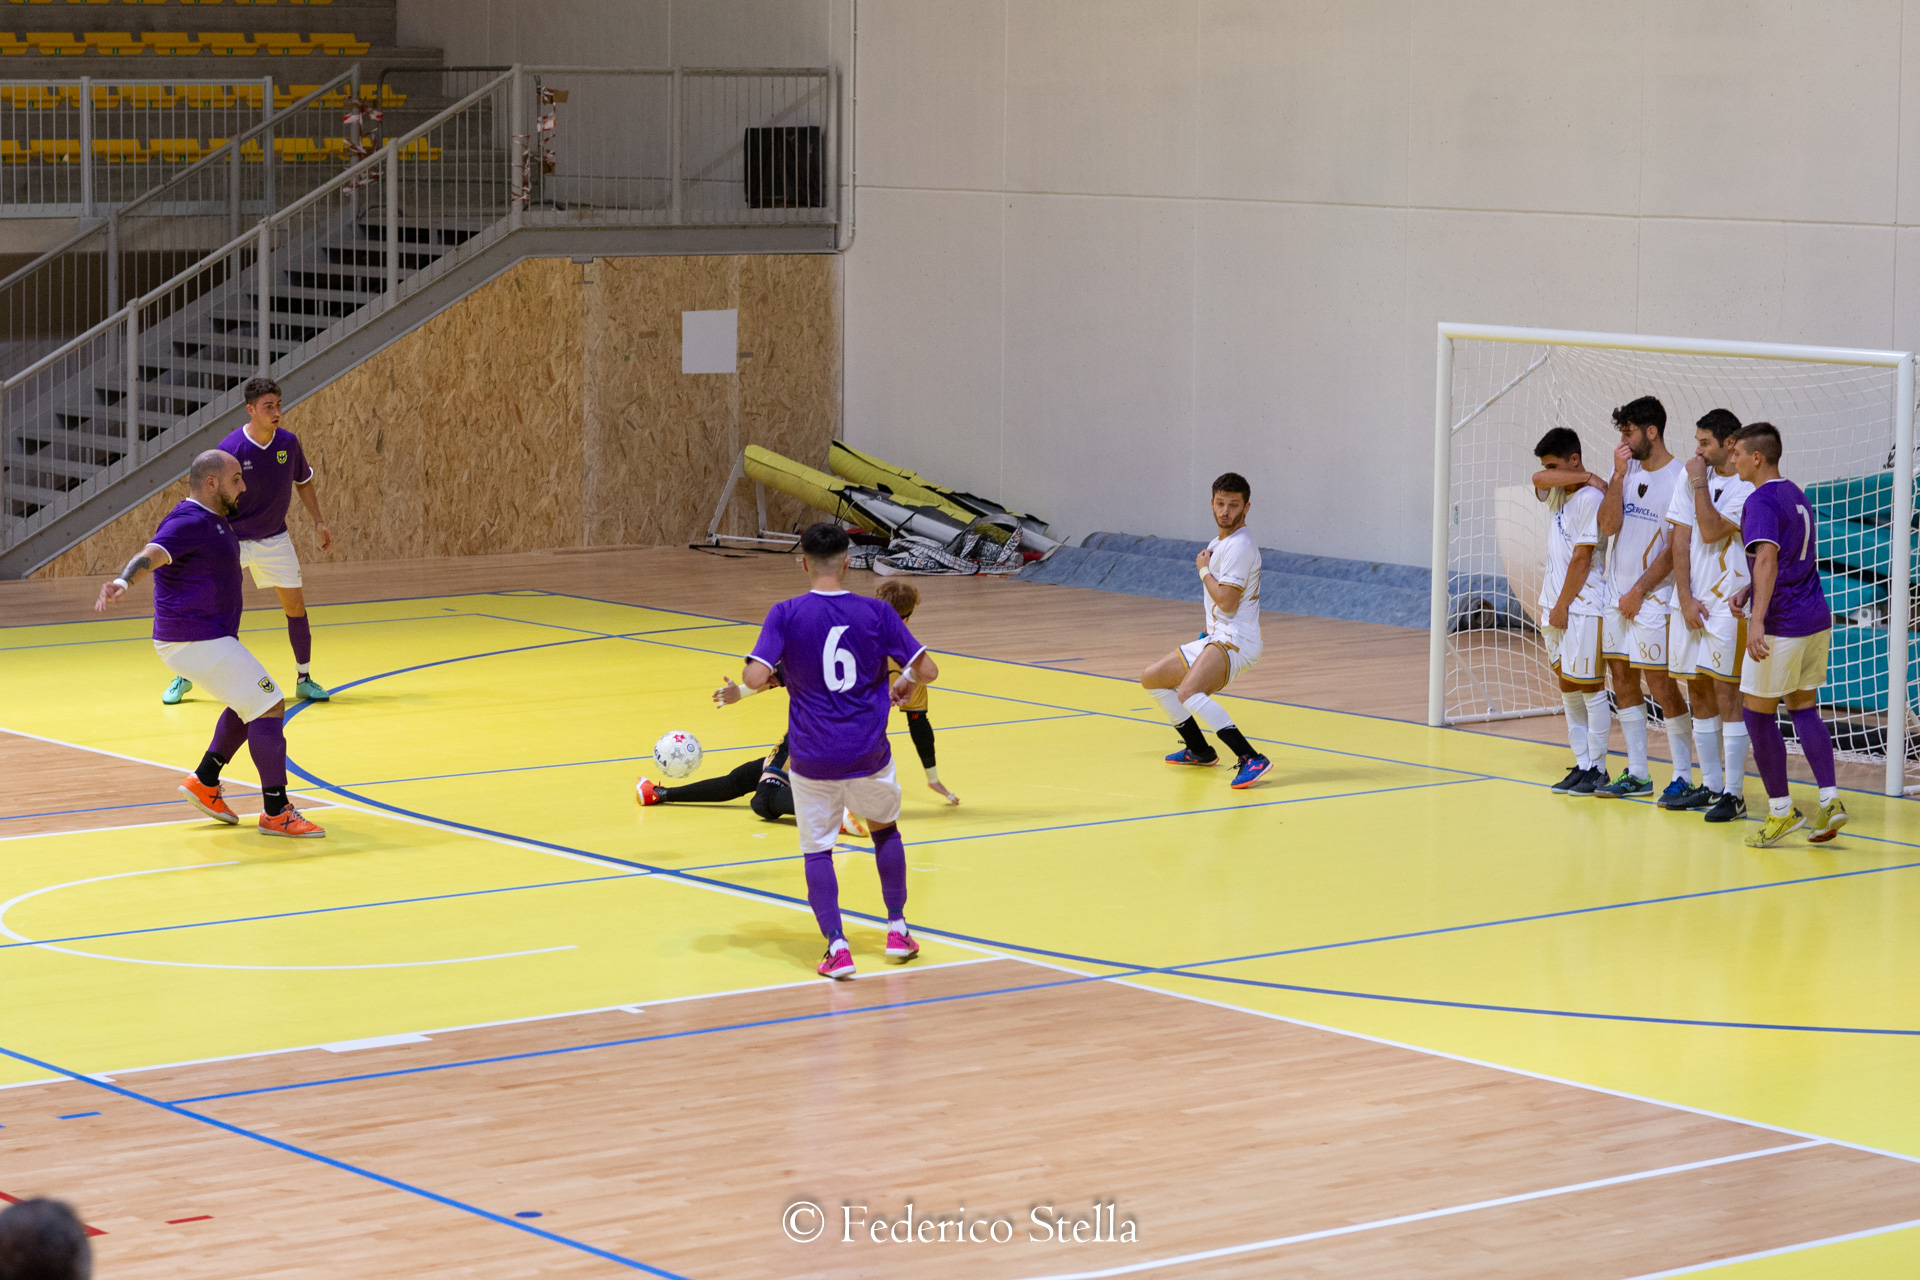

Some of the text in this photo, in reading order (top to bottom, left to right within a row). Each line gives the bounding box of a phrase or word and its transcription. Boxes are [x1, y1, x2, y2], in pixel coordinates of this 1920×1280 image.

[823, 625, 856, 693] 6
[1638, 641, 1662, 661] 80
[1711, 651, 1722, 669] 8
